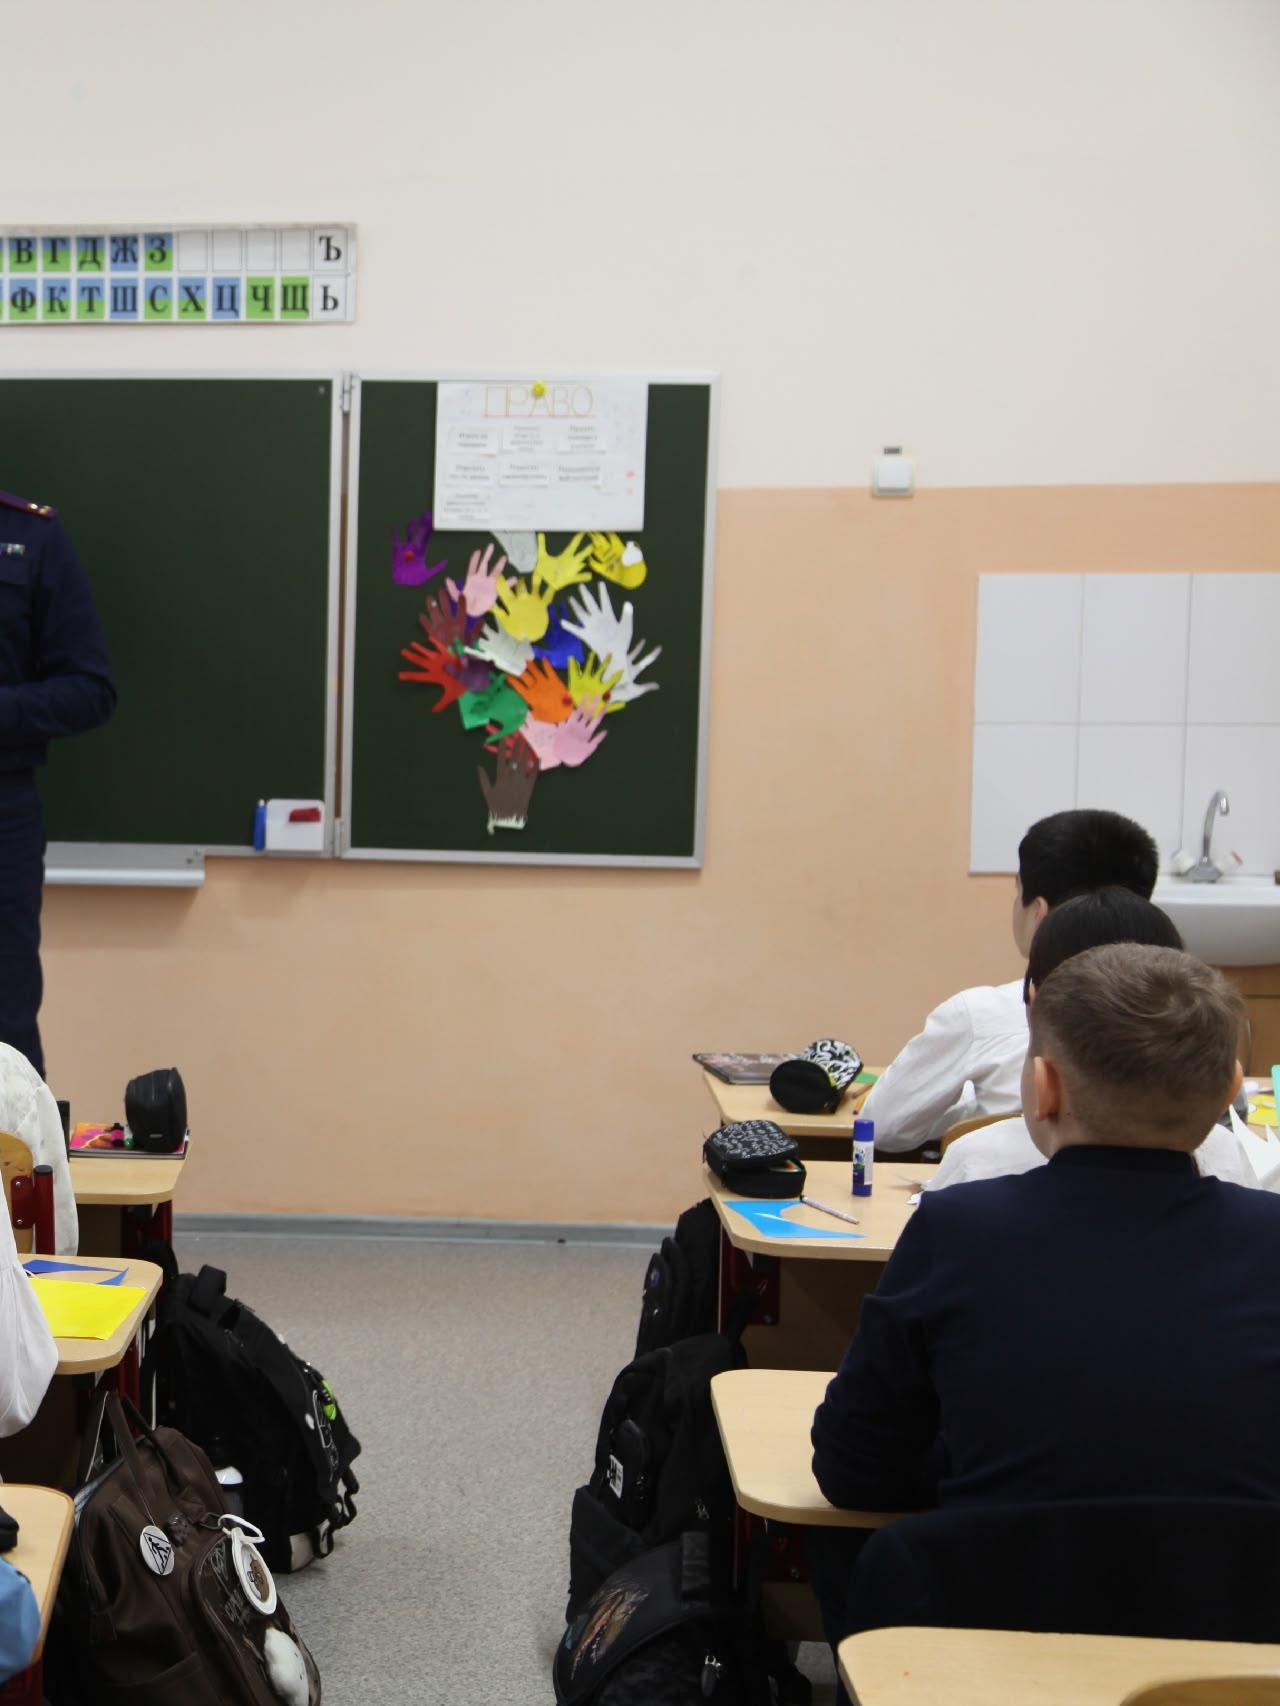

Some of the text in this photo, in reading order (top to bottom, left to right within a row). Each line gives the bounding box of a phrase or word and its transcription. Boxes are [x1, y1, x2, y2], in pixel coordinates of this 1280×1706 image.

[13, 237, 33, 264] В
[47, 237, 67, 264] Г
[78, 237, 102, 271] Д
[110, 237, 139, 263] Ж
[148, 236, 167, 263] З
[319, 236, 342, 261] Ъ
[10, 287, 37, 313] Ф
[48, 286, 67, 313] К
[81, 286, 100, 313] Т
[112, 285, 137, 313] Ш
[148, 286, 167, 313] С
[182, 285, 203, 312] Х
[217, 285, 238, 318] Ц
[252, 285, 270, 312] Ч
[281, 284, 309, 317] Щ
[322, 285, 339, 311] Ь
[484, 384, 594, 418] ПРАВО
